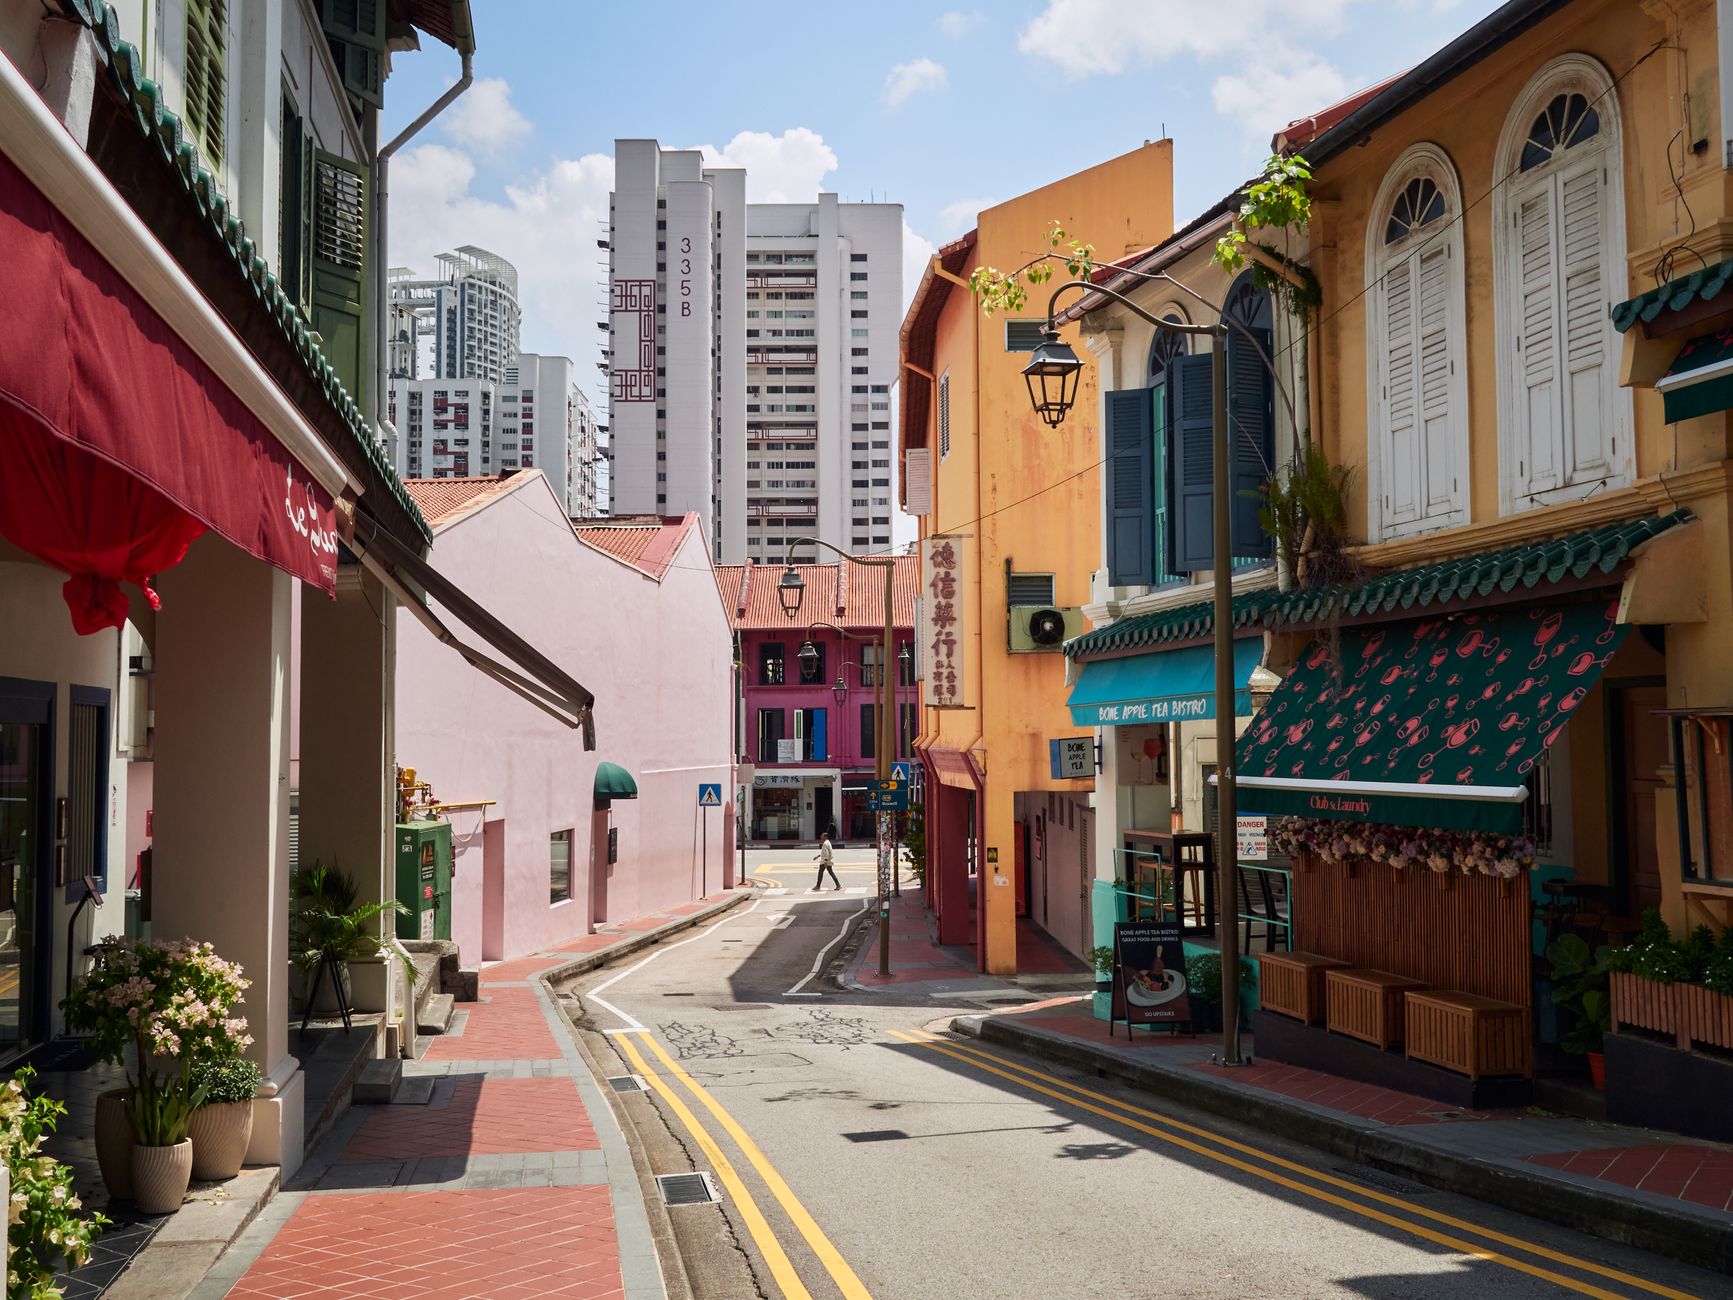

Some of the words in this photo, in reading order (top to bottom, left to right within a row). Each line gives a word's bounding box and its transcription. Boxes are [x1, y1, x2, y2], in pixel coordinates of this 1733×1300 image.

[680, 237, 692, 317] 335B
[1098, 706, 1119, 721] BONE
[1122, 704, 1148, 720] APPLE
[1151, 702, 1169, 718] TEA
[1172, 698, 1207, 716] BISTRO
[1067, 742, 1086, 752] BONE
[1068, 752, 1086, 761] APPLE
[1071, 761, 1084, 771] TEA
[1224, 766, 1232, 780] 4
[1310, 795, 1329, 809] Club
